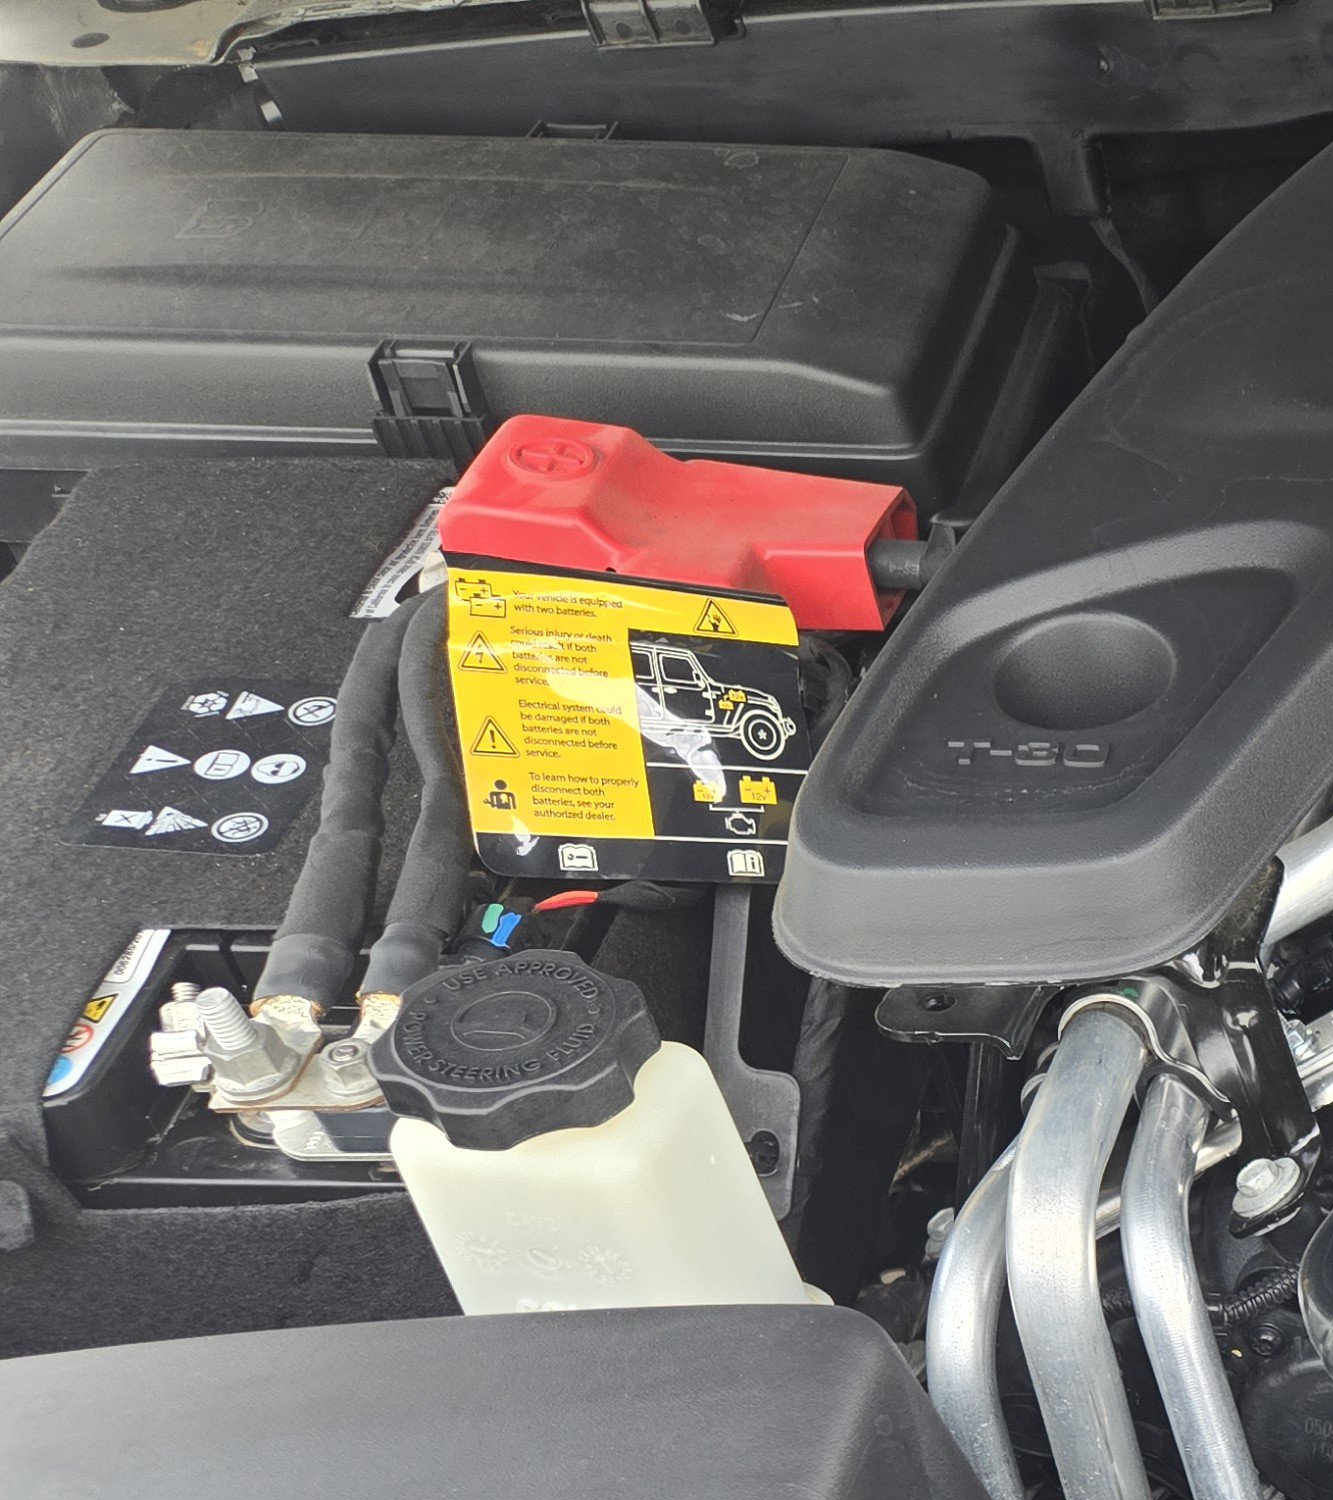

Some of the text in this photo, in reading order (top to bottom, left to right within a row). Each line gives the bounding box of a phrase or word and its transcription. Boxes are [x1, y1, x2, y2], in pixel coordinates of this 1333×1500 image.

[514, 603, 597, 618] with two batteries.
[510, 626, 543, 637] Serious
[585, 633, 612, 643] death
[567, 643, 573, 652] if
[575, 642, 597, 653] both
[555, 655, 570, 664] are
[571, 655, 588, 664] not
[578, 667, 609, 678] before
[515, 676, 549, 687] service.
[518, 699, 560, 711] Electrical
[562, 704, 594, 714] system
[520, 712, 611, 727] be damaged if both
[522, 724, 597, 737] batteries are not
[524, 736, 618, 750] disconnected before
[526, 748, 561, 758] service.
[529, 772, 639, 788] To learn how to properly
[531, 785, 605, 797] disconnect both
[532, 796, 615, 810] batteries, see your
[534, 808, 616, 821] authorized dealer.
[442, 960, 601, 1000] USE APPROVED
[403, 1010, 596, 1083] POWER STEERING FLUID
